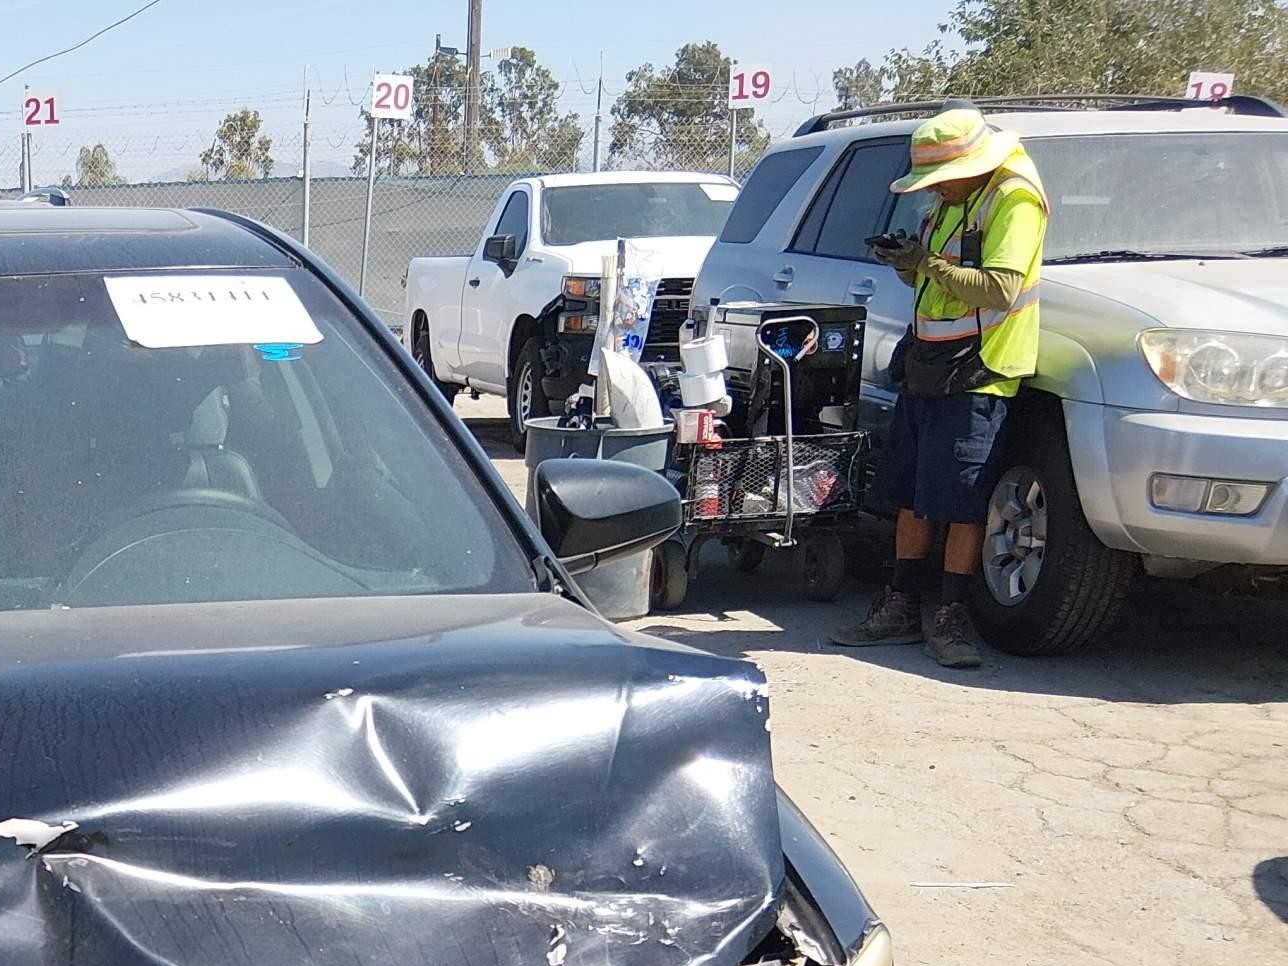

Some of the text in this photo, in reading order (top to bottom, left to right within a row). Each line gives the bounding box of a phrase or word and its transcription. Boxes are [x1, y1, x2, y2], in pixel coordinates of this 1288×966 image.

[375, 82, 409, 110] 20
[732, 71, 770, 99] 19
[25, 97, 59, 125] 21
